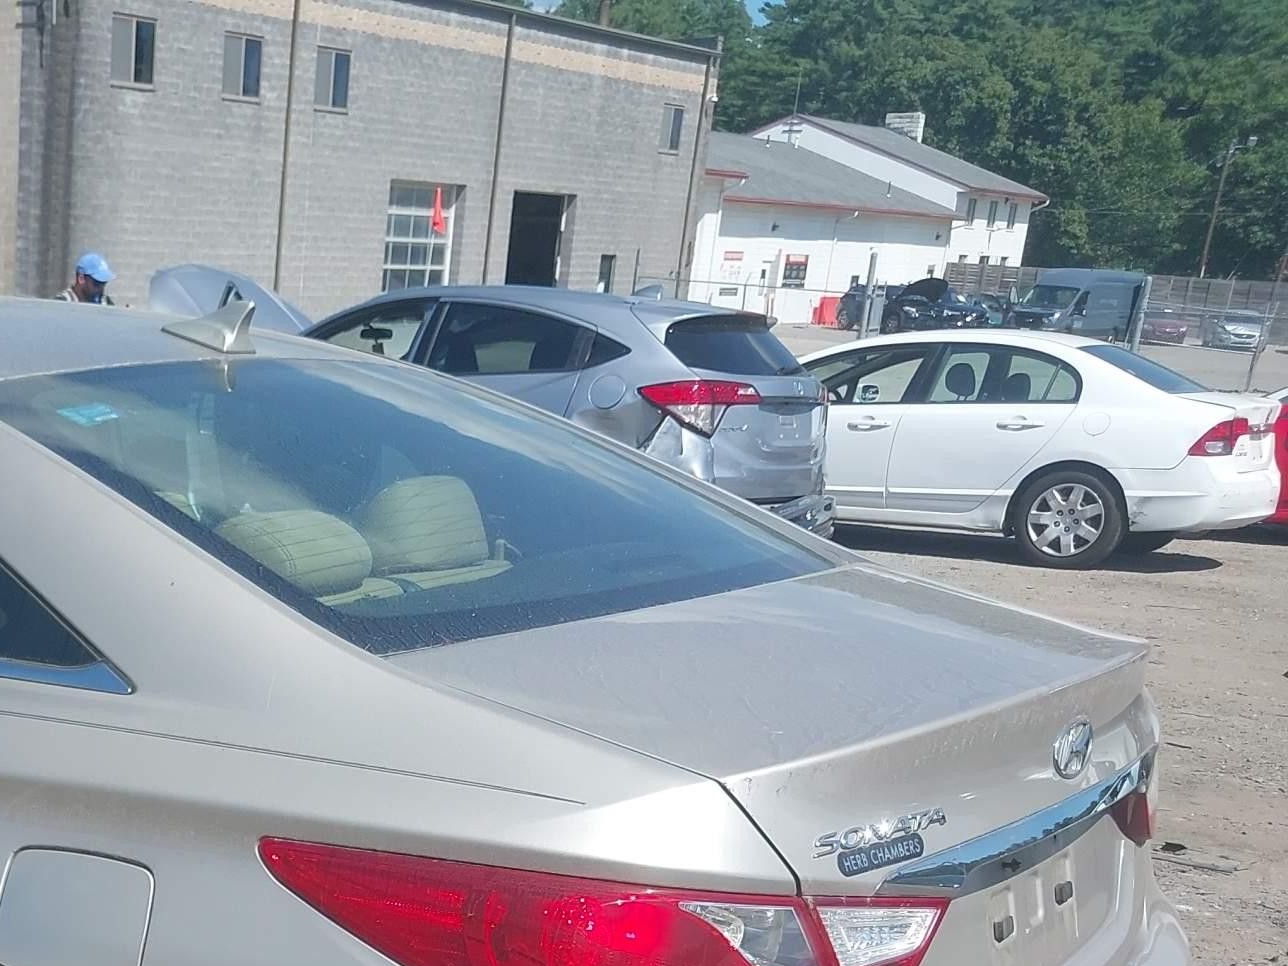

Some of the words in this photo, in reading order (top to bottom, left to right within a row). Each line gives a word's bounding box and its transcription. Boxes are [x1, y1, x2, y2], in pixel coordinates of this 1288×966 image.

[812, 808, 947, 859] SONATA
[843, 851, 869, 873] HERB
[870, 837, 921, 865] CHAMBERS
